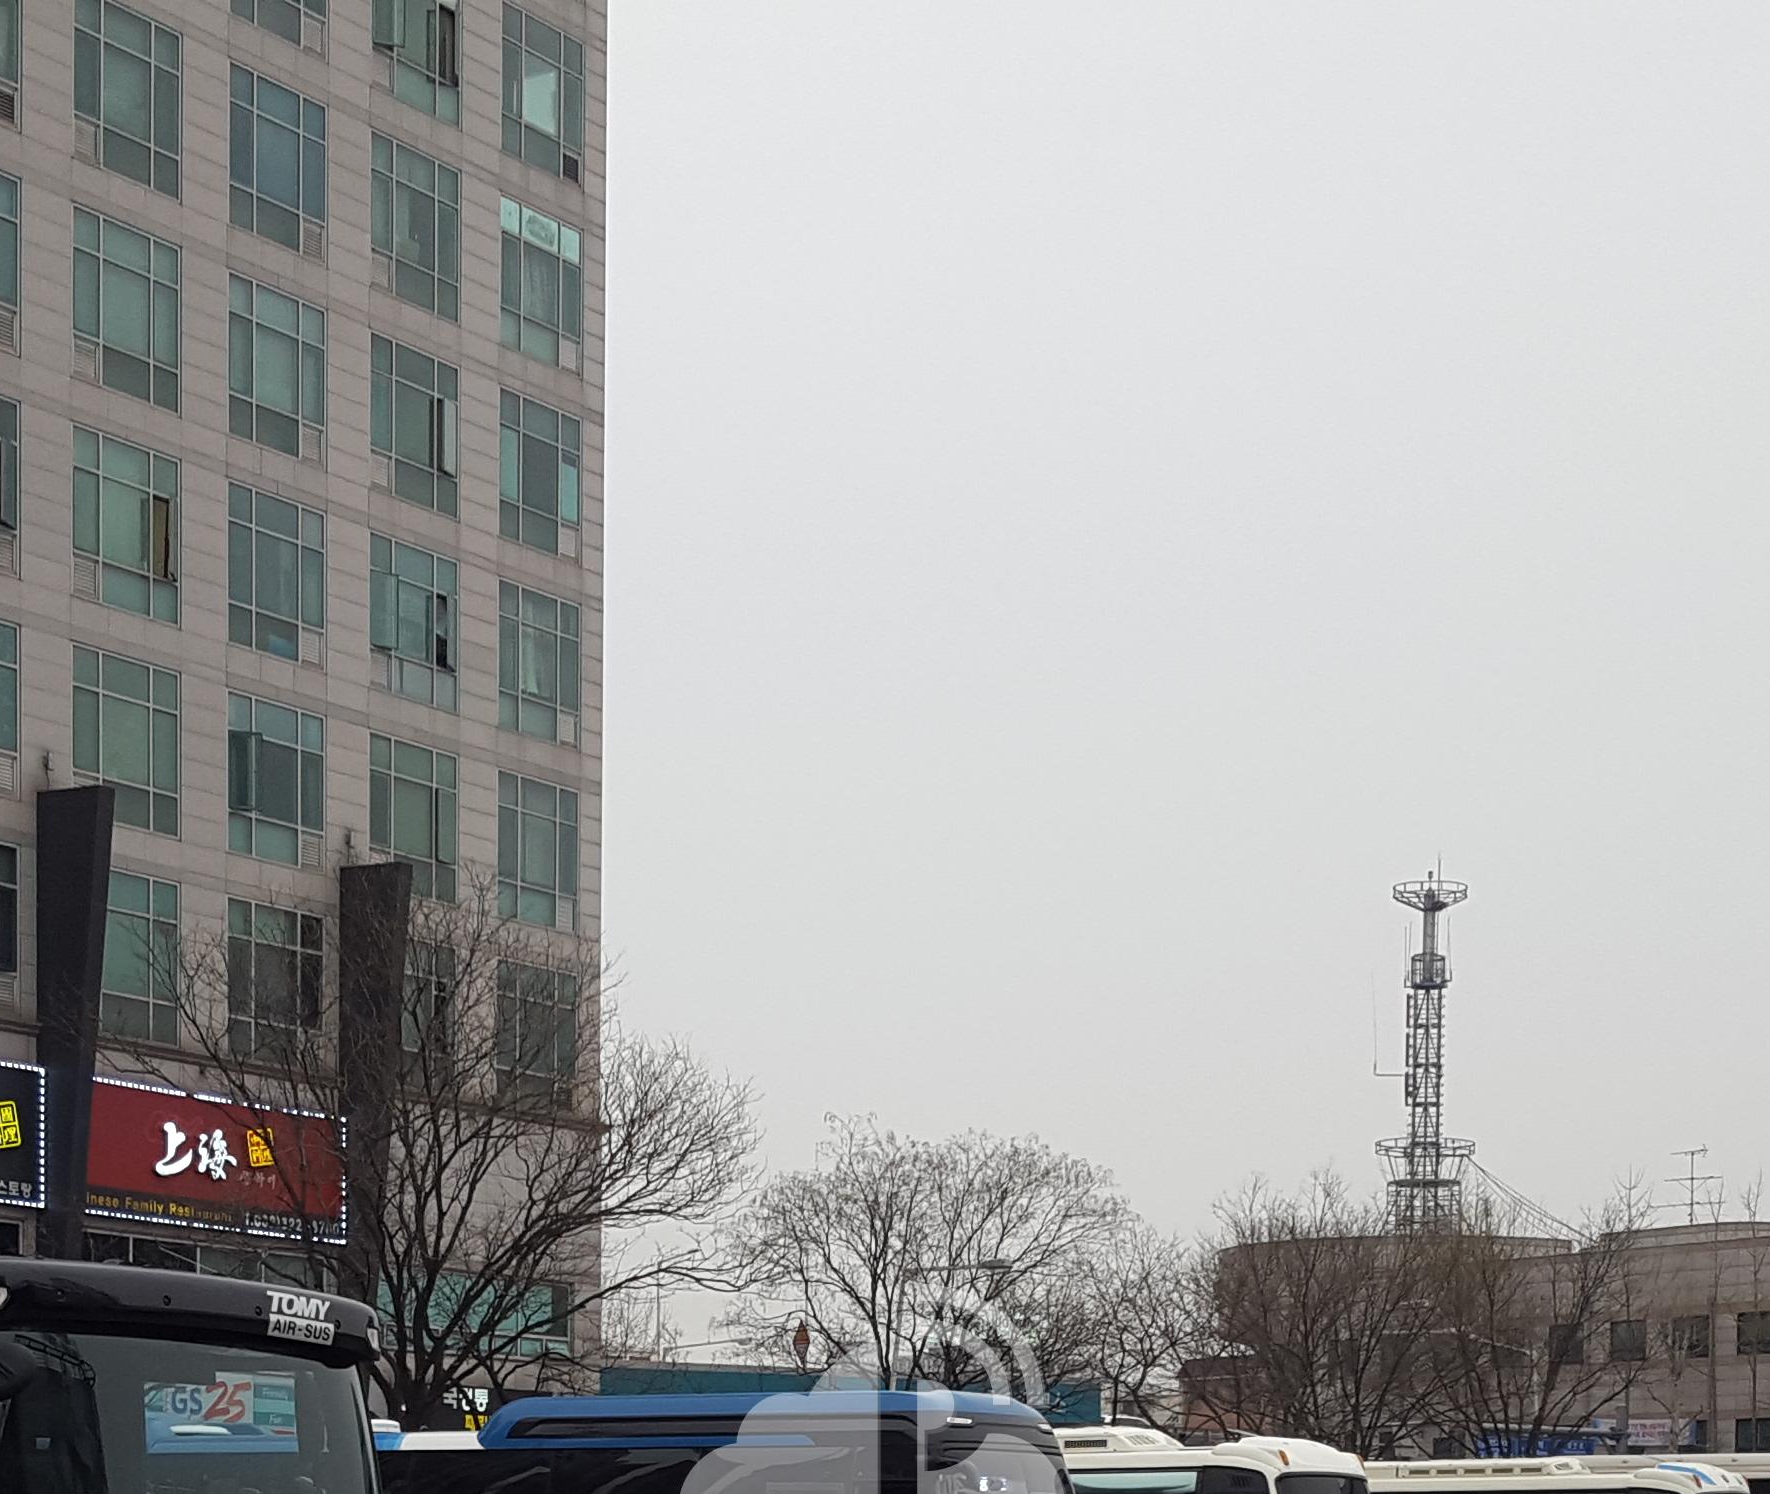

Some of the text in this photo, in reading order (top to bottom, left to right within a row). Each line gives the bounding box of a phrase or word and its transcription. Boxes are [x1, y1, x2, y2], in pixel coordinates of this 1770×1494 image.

[267, 1290, 331, 1322] TOMY
[271, 1319, 333, 1341] AIR-SUS
[170, 1380, 253, 1424] GS25
